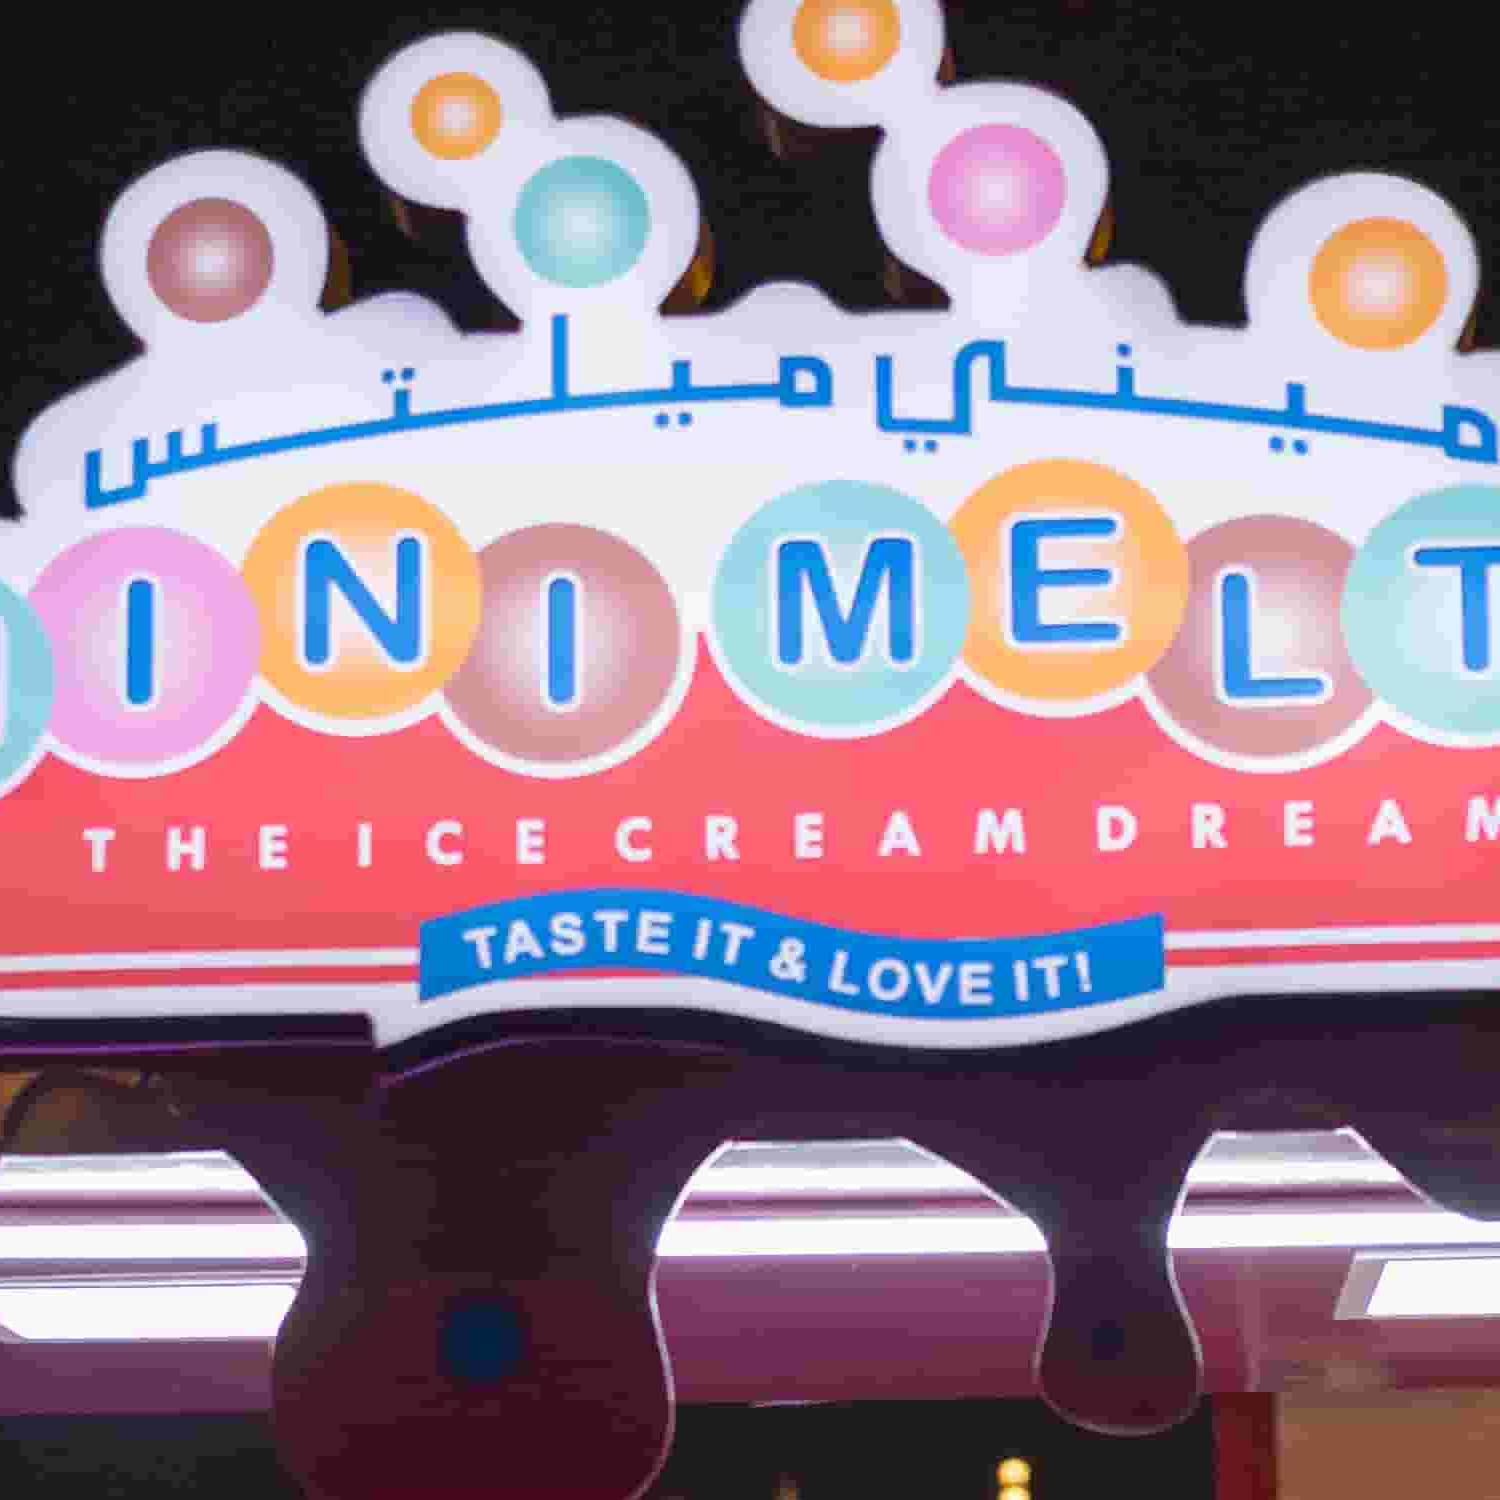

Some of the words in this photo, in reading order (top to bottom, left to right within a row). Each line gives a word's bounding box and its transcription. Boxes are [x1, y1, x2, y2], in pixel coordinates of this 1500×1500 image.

[82, 312, 834, 510] ميلتس
[873, 339, 1500, 466] ميني
[81, 823, 290, 874] THE
[356, 817, 547, 869] ICE
[613, 806, 1028, 863] CREAM
[462, 909, 674, 970] TASTE
[692, 917, 757, 966] IT
[768, 936, 808, 984] &
[827, 949, 995, 1006] LOVE
[1011, 949, 1094, 1003] IT!
